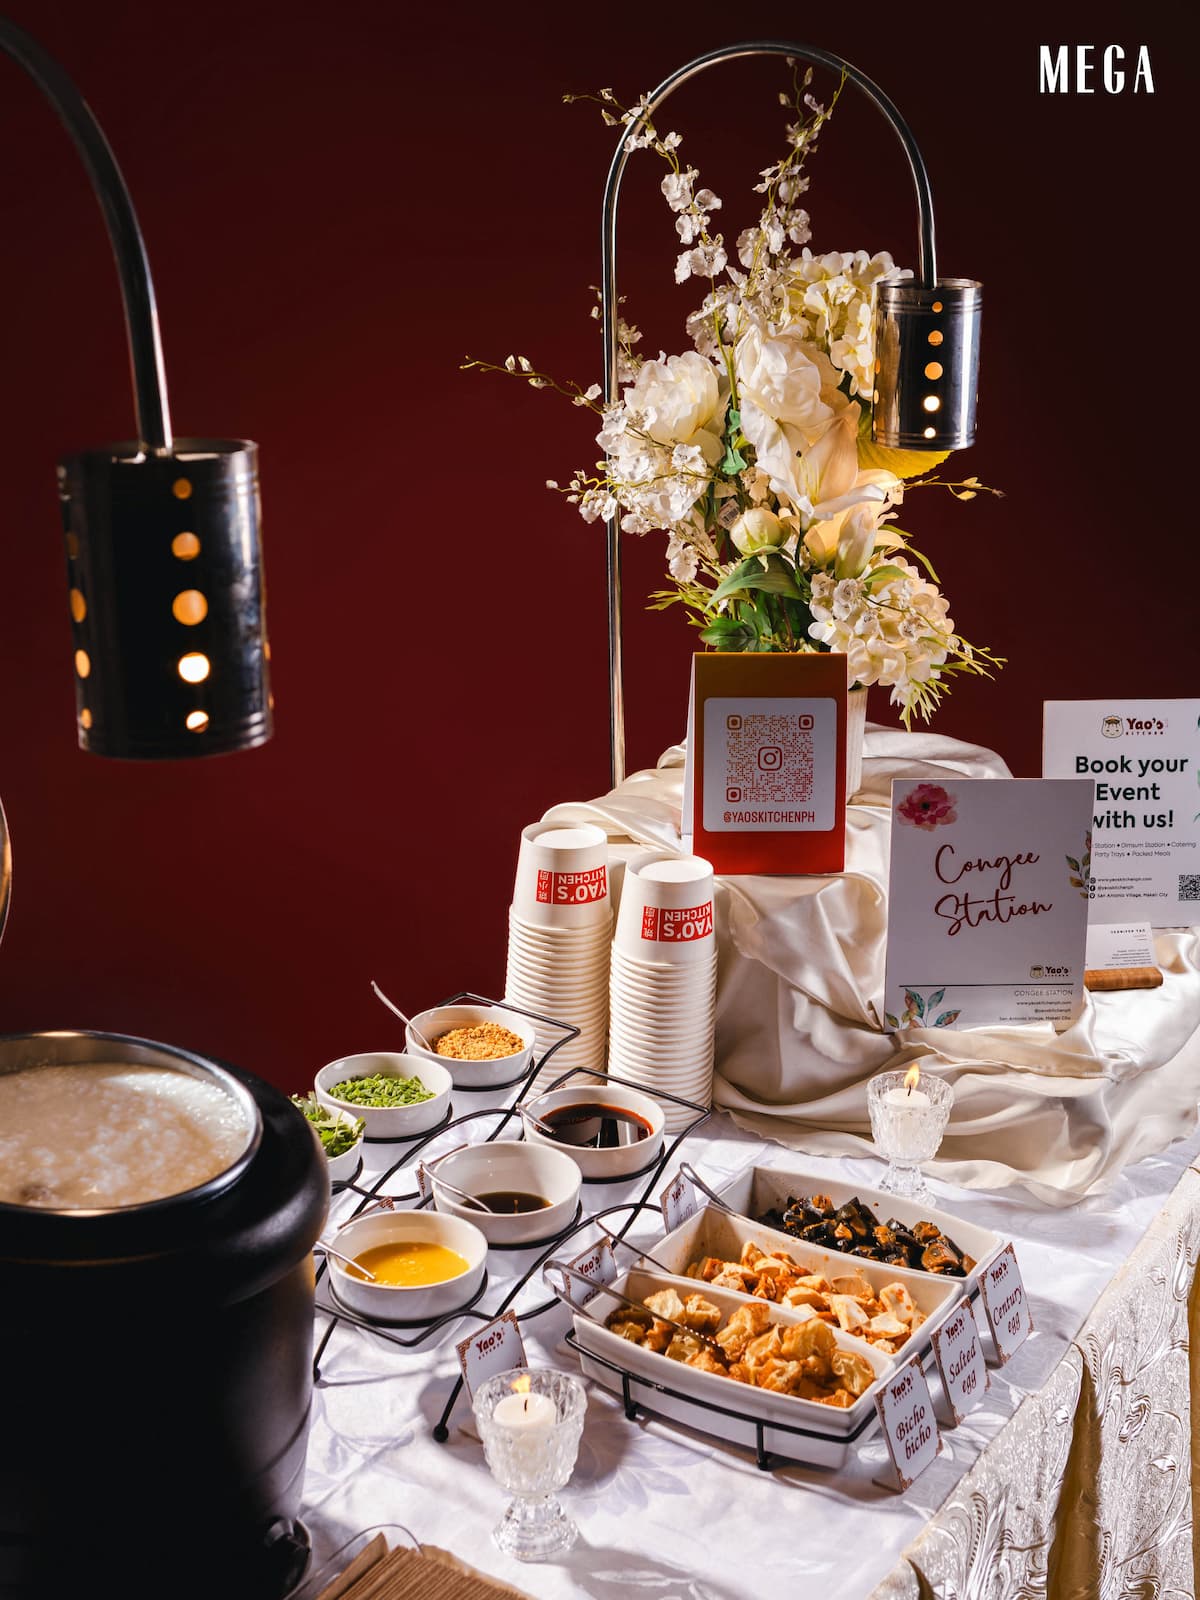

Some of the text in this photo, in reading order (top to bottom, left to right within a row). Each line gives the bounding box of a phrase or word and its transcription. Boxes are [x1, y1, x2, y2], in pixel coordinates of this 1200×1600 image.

[1126, 718, 1164, 730] Yao's
[1075, 755, 1189, 778] Book your
[1096, 783, 1161, 801] Event
[723, 811, 815, 823] @YAOSKITCHENPH
[1143, 809, 1174, 828] us!
[1171, 841, 1197, 849] Catering
[558, 868, 605, 884] KITCHEN
[935, 844, 1040, 890] Congee
[557, 880, 607, 902] YAO'S
[664, 904, 711, 921] KITCHEN
[934, 889, 1053, 936] Station
[663, 916, 713, 939] YAO'S
[1045, 966, 1069, 974] Yao's
[990, 1262, 1007, 1282] Yao's
[993, 1285, 1022, 1327] Century
[945, 1317, 963, 1340] Yao's
[1007, 1312, 1021, 1336] egg
[475, 1331, 502, 1353] Yao's
[949, 1336, 976, 1384] Salted
[890, 1376, 912, 1399] Yao's
[962, 1369, 977, 1395] egg
[896, 1404, 925, 1443] Bicho
[905, 1424, 931, 1460] bicho
